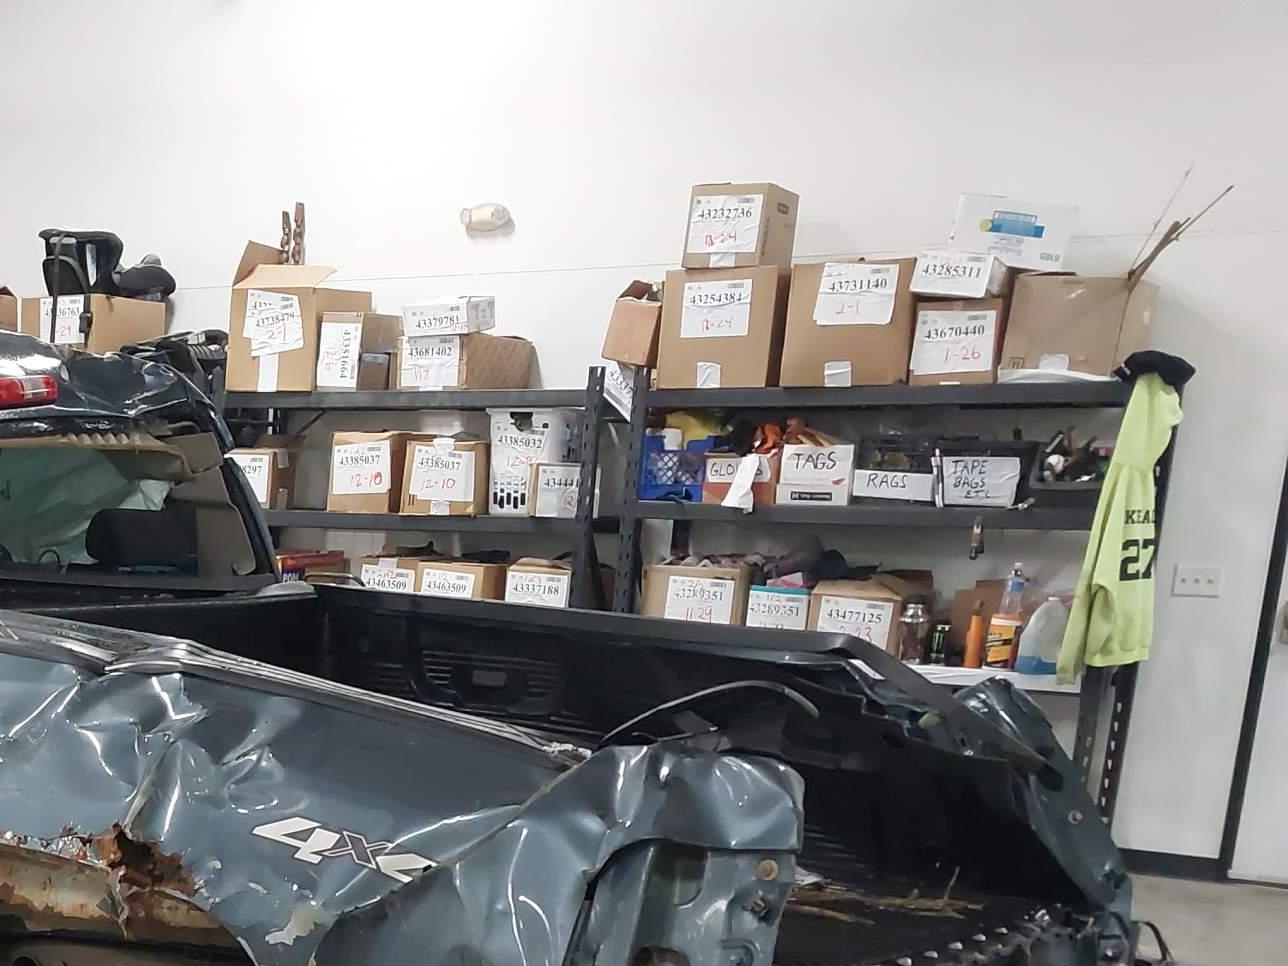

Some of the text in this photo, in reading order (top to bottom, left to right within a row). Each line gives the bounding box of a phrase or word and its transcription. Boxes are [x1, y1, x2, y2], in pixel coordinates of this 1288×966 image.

[698, 207, 752, 221] 43232736
[921, 264, 982, 279] 43285311
[829, 277, 887, 292] 43731140
[689, 292, 742, 305] 43254384
[416, 314, 459, 329] 43379781
[924, 324, 985, 340] 43670440
[408, 347, 452, 358] 43681402
[943, 346, 982, 361] 1-26
[498, 435, 544, 450] 43385032
[339, 455, 380, 466] 43385037
[418, 457, 460, 471] 43385037
[794, 451, 838, 470] TAGS
[951, 459, 988, 475] TAPE
[421, 478, 457, 491] 12-10
[866, 473, 908, 490] RAGS
[953, 476, 986, 488] BAGS
[1119, 538, 1157, 582] 27
[366, 577, 407, 590] 43463509
[427, 580, 467, 593] 43463509
[512, 583, 560, 596] 43337188
[825, 608, 883, 624] 43477125
